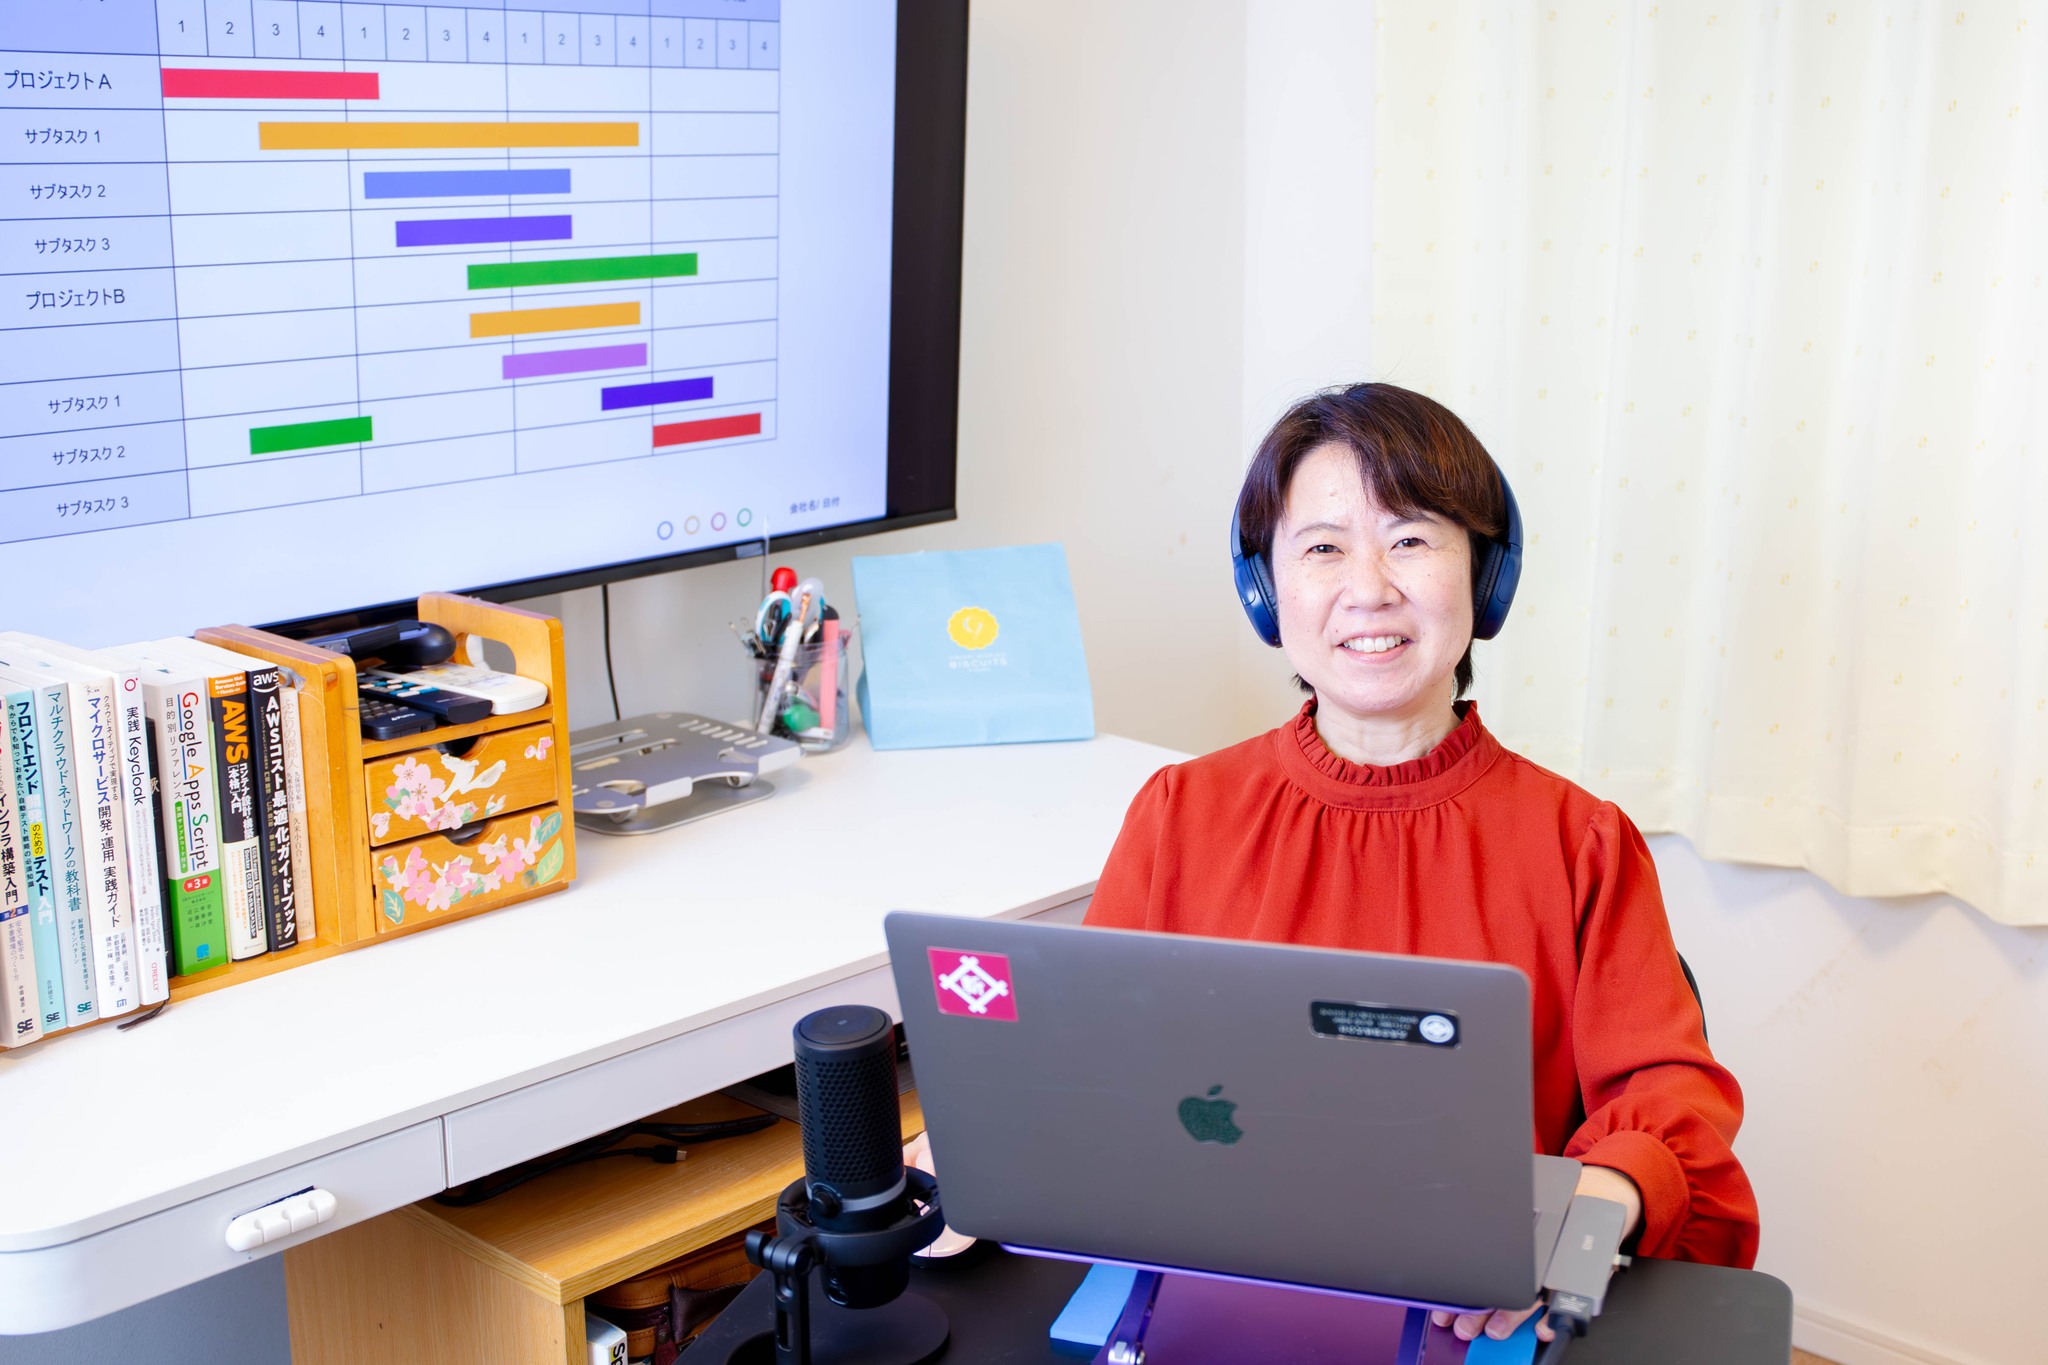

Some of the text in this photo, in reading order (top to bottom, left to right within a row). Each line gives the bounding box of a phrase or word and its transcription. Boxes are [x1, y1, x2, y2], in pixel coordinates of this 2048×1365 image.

[178, 20, 185, 33] 1
[225, 21, 235, 35] 2
[272, 23, 281, 37] 3
[316, 25, 325, 37] 4
[361, 26, 367, 39] 1
[402, 27, 410, 41] 2
[443, 29, 451, 42] 3
[482, 31, 490, 43] 4
[521, 32, 527, 44] 1
[558, 33, 566, 46] 2
[594, 34, 602, 47] 3
[629, 36, 637, 47] 4
[664, 37, 670, 49] 1
[697, 37, 704, 50] 2
[729, 39, 737, 51] 3
[761, 40, 768, 51] 4
[25, 128, 100, 144] サブタスク 1
[30, 184, 106, 199] サブタスク 2
[35, 238, 111, 253] サブタスク 3
[27, 289, 125, 309] プロジェクトB
[49, 396, 120, 413] サブタスク 1
[53, 446, 126, 465] サブタスク 2
[57, 496, 129, 517] サブタスク 3
[253, 671, 279, 686] aws
[127, 707, 140, 733] 実践
[179, 691, 202, 757] Google
[222, 700, 249, 764] AWS
[166, 697, 183, 800] 目的別リファレンス
[127, 737, 146, 805] Keycloak
[183, 763, 205, 811] Apps
[48, 692, 82, 912] マルチクラウドネットワークの教科書
[266, 696, 295, 938] AWSコスト最適化ガイドブック
[189, 813, 209, 870] Script
[77, 1001, 91, 1013] SE
[46, 1012, 60, 1023] SE
[17, 1018, 33, 1034] SE
